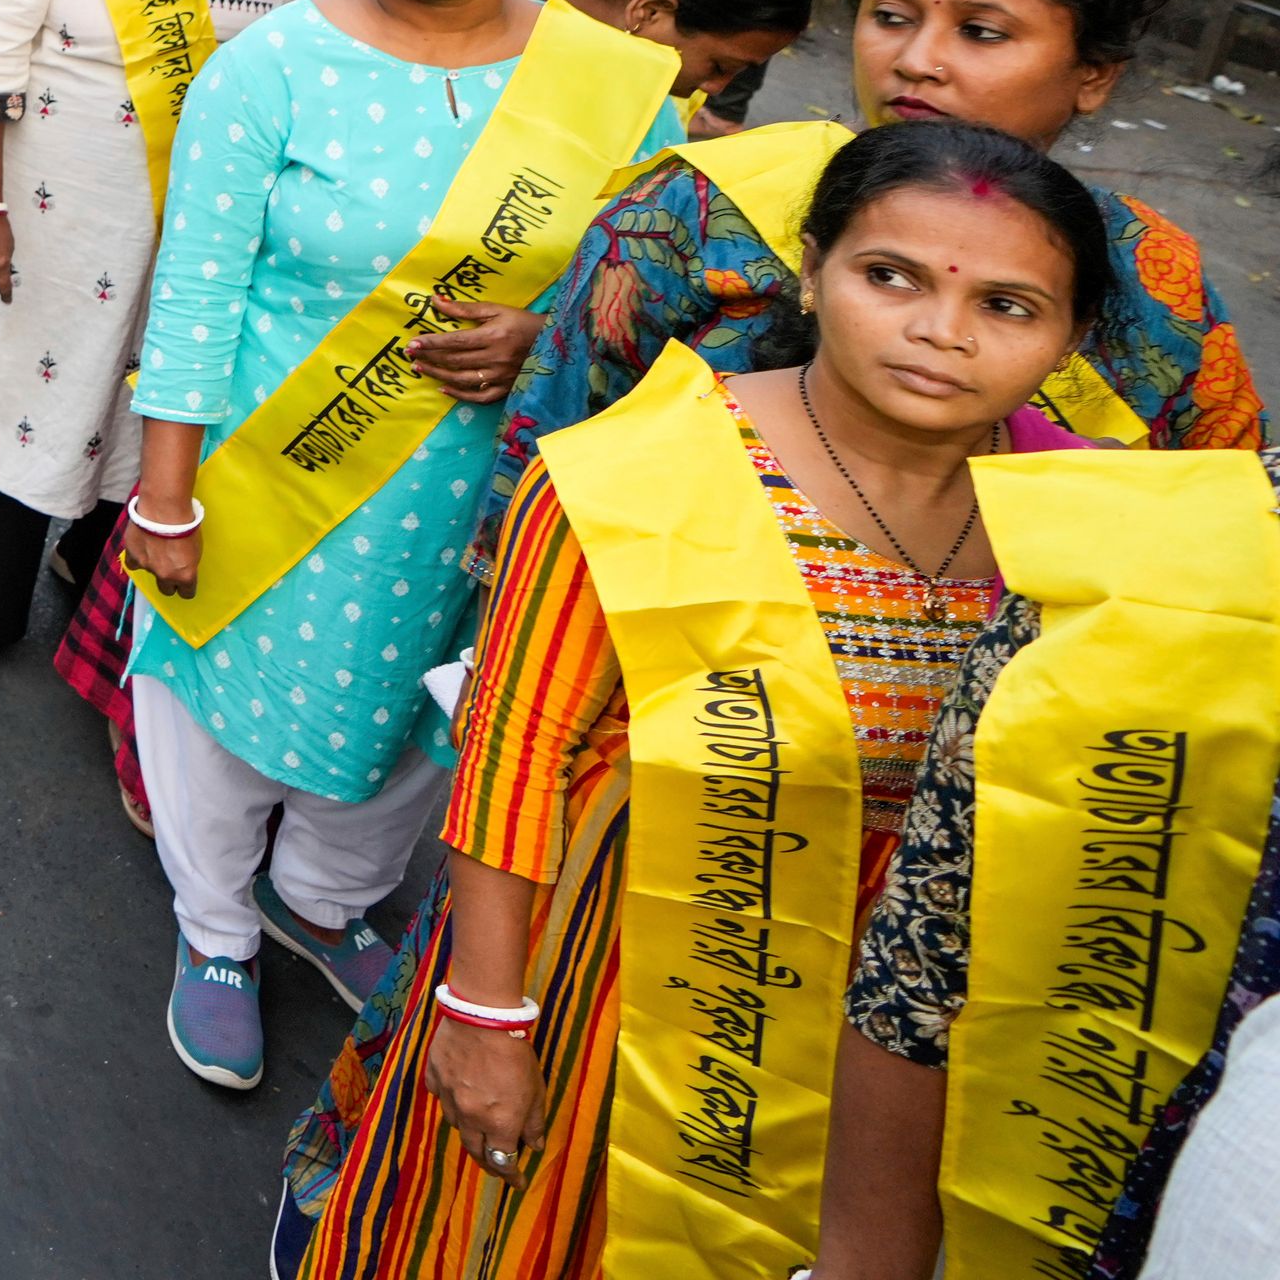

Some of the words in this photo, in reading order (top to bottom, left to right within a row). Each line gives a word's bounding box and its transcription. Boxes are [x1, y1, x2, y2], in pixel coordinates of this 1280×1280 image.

[281, 392, 376, 472] অত্যাচারের
[695, 669, 790, 823] অত্যাচারের
[1076, 730, 1193, 900] অত্যাচারের
[203, 964, 243, 989] AIR
[353, 927, 378, 952] AIR
[686, 919, 803, 989] নারী
[664, 977, 777, 1067] পুরুষ
